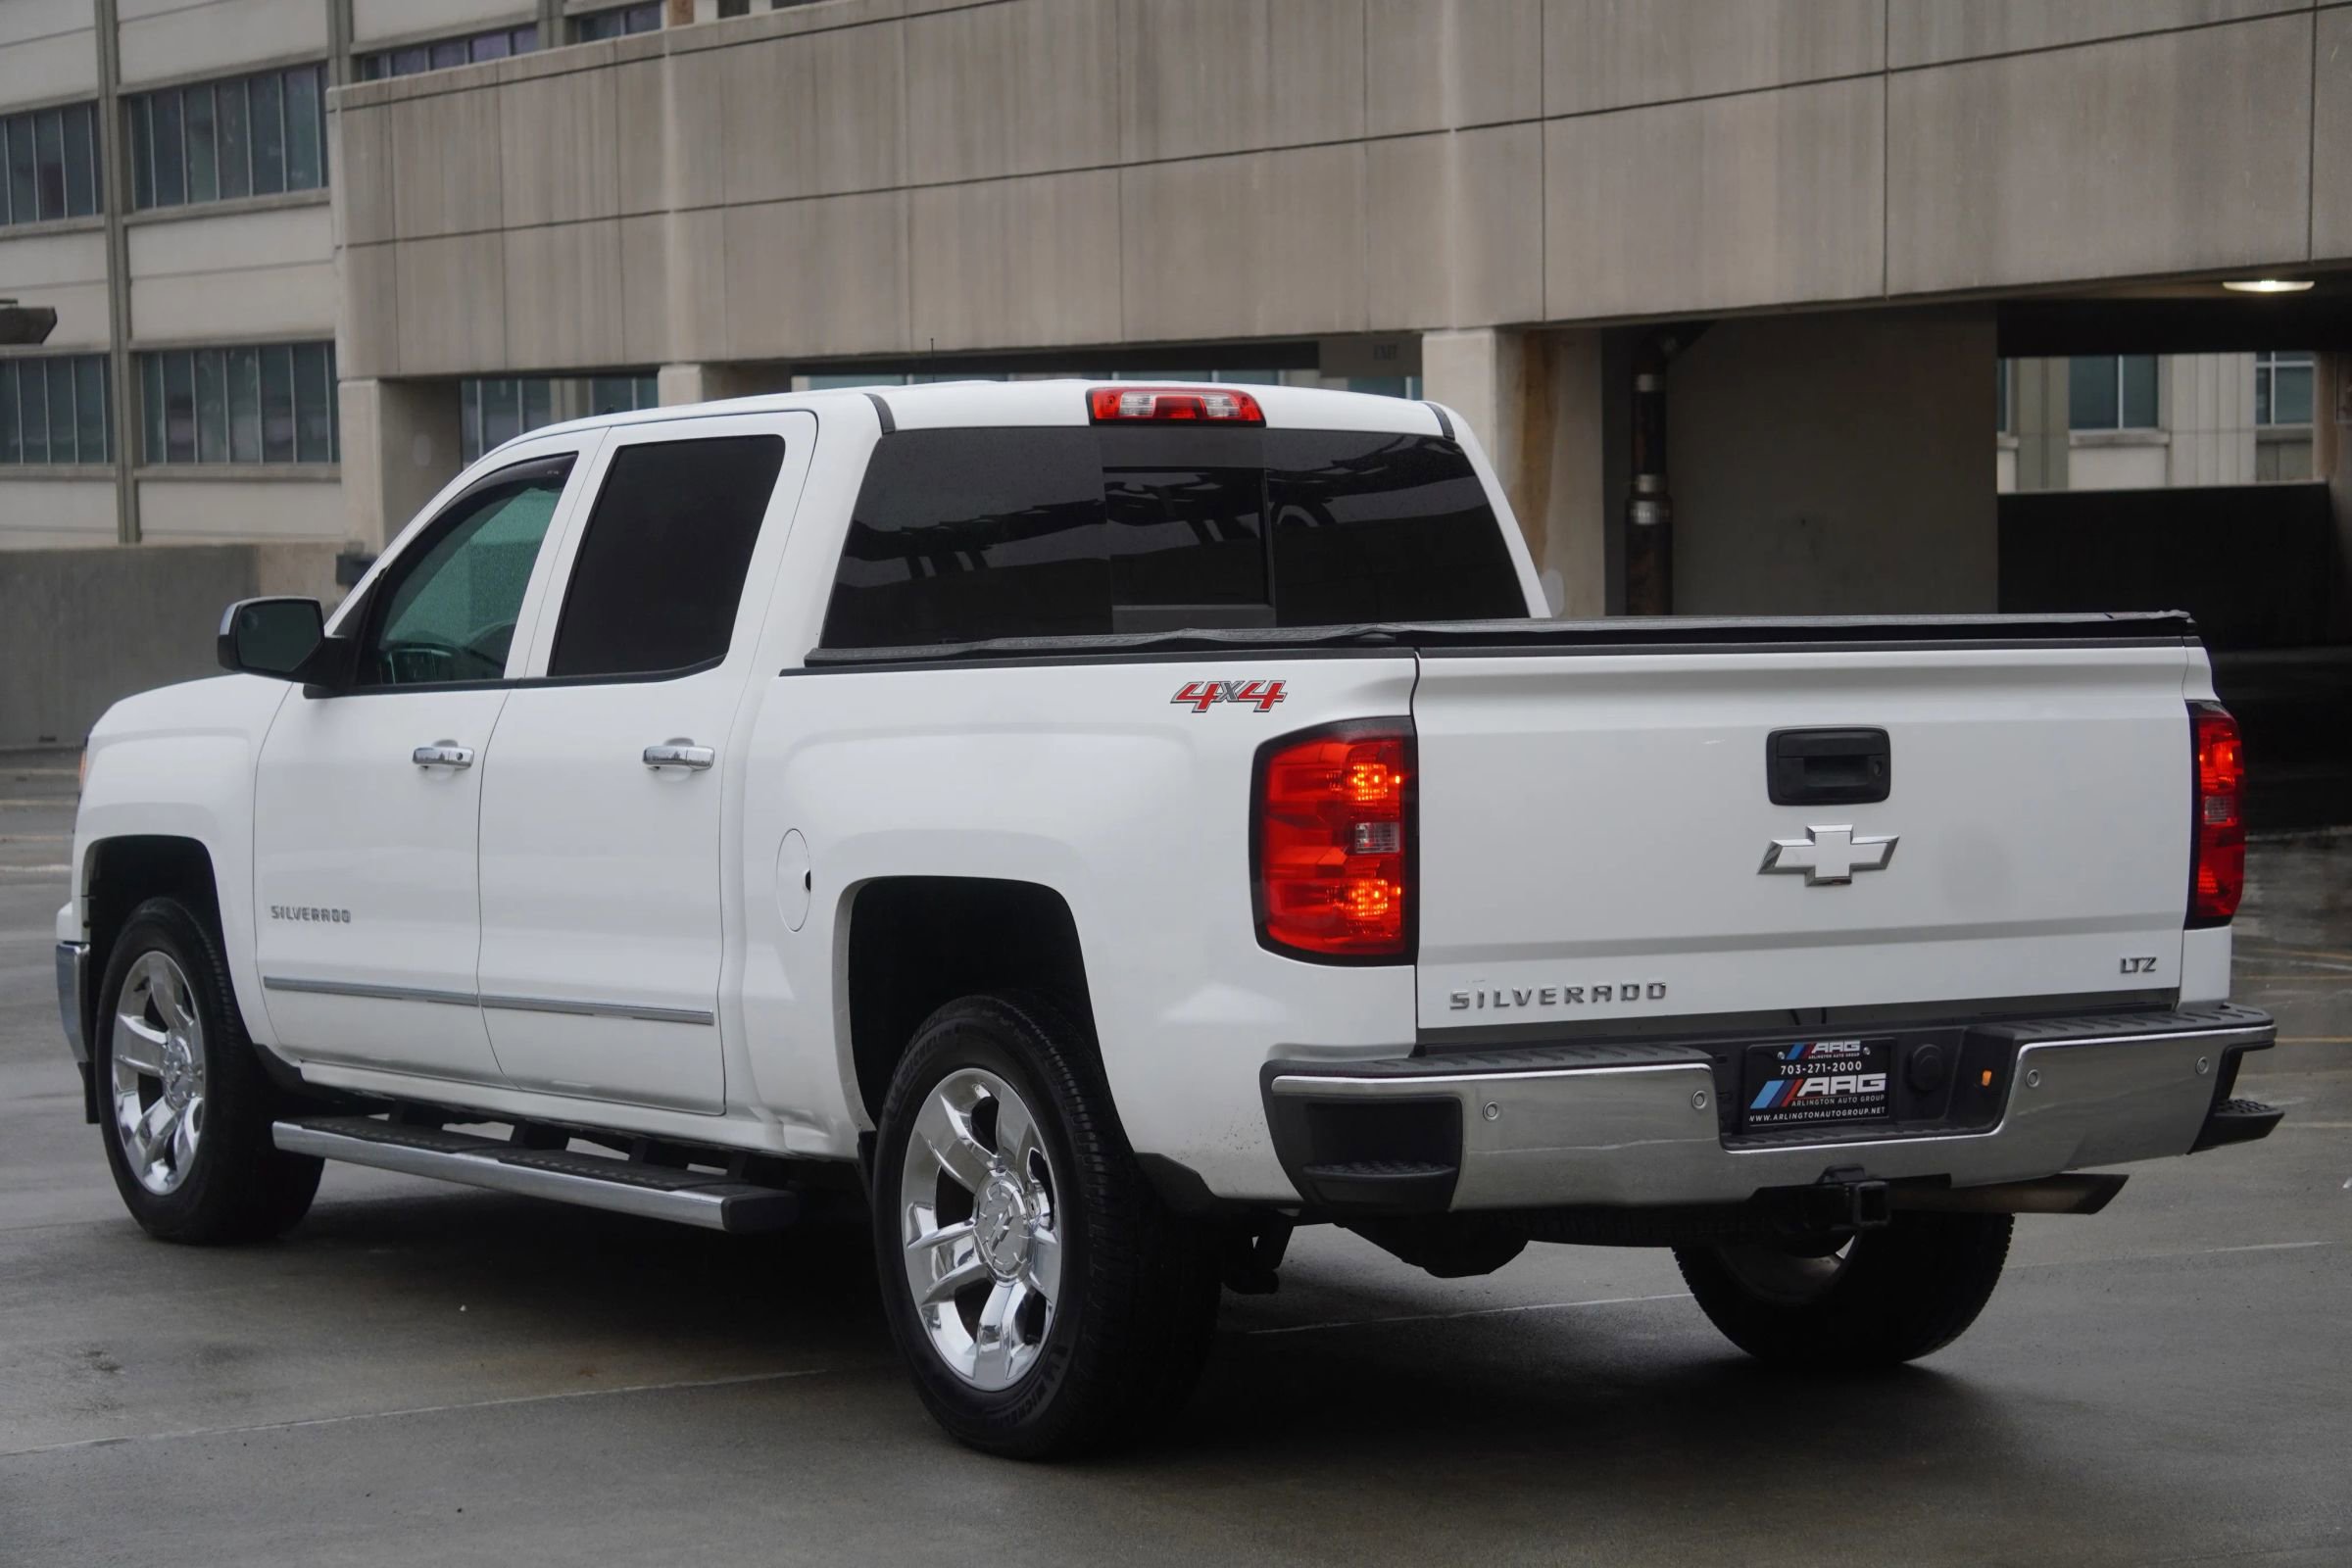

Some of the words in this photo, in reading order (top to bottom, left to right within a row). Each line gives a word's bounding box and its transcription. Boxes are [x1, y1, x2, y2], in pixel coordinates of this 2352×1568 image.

[270, 905, 352, 923] SILVERADO
[2120, 956, 2158, 974] LTZ
[1449, 982, 1667, 1010] SILVERADO
[1780, 1060, 1862, 1076] 703-271-2000
[1796, 1072, 1886, 1098] AAG
[1791, 1098, 1836, 1107] ARLINGTON
[1860, 1094, 1885, 1102] GROUP
